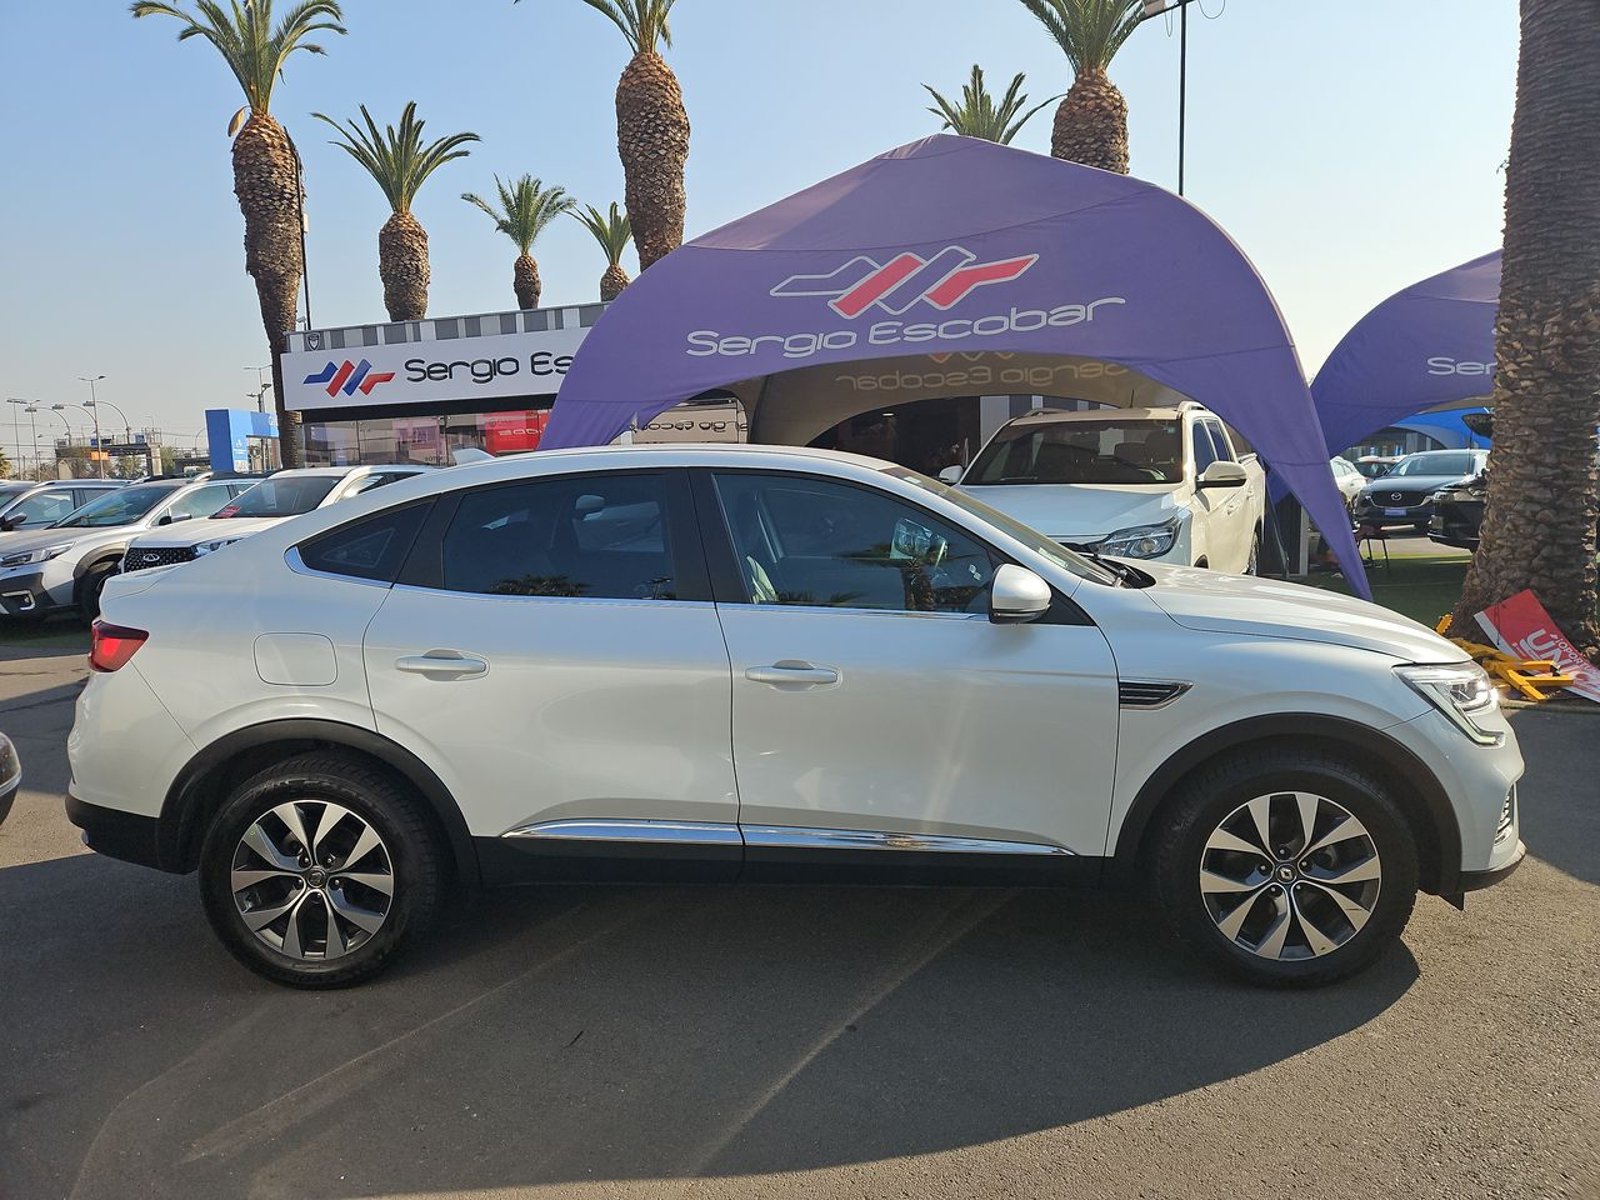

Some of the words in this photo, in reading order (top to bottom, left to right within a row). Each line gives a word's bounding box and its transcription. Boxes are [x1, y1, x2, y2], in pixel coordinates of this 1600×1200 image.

[686, 330, 857, 358] Sergio
[868, 297, 1126, 345] Escobar
[404, 358, 520, 384] Sergio
[530, 351, 574, 376] Es
[1426, 356, 1498, 376] Ser
